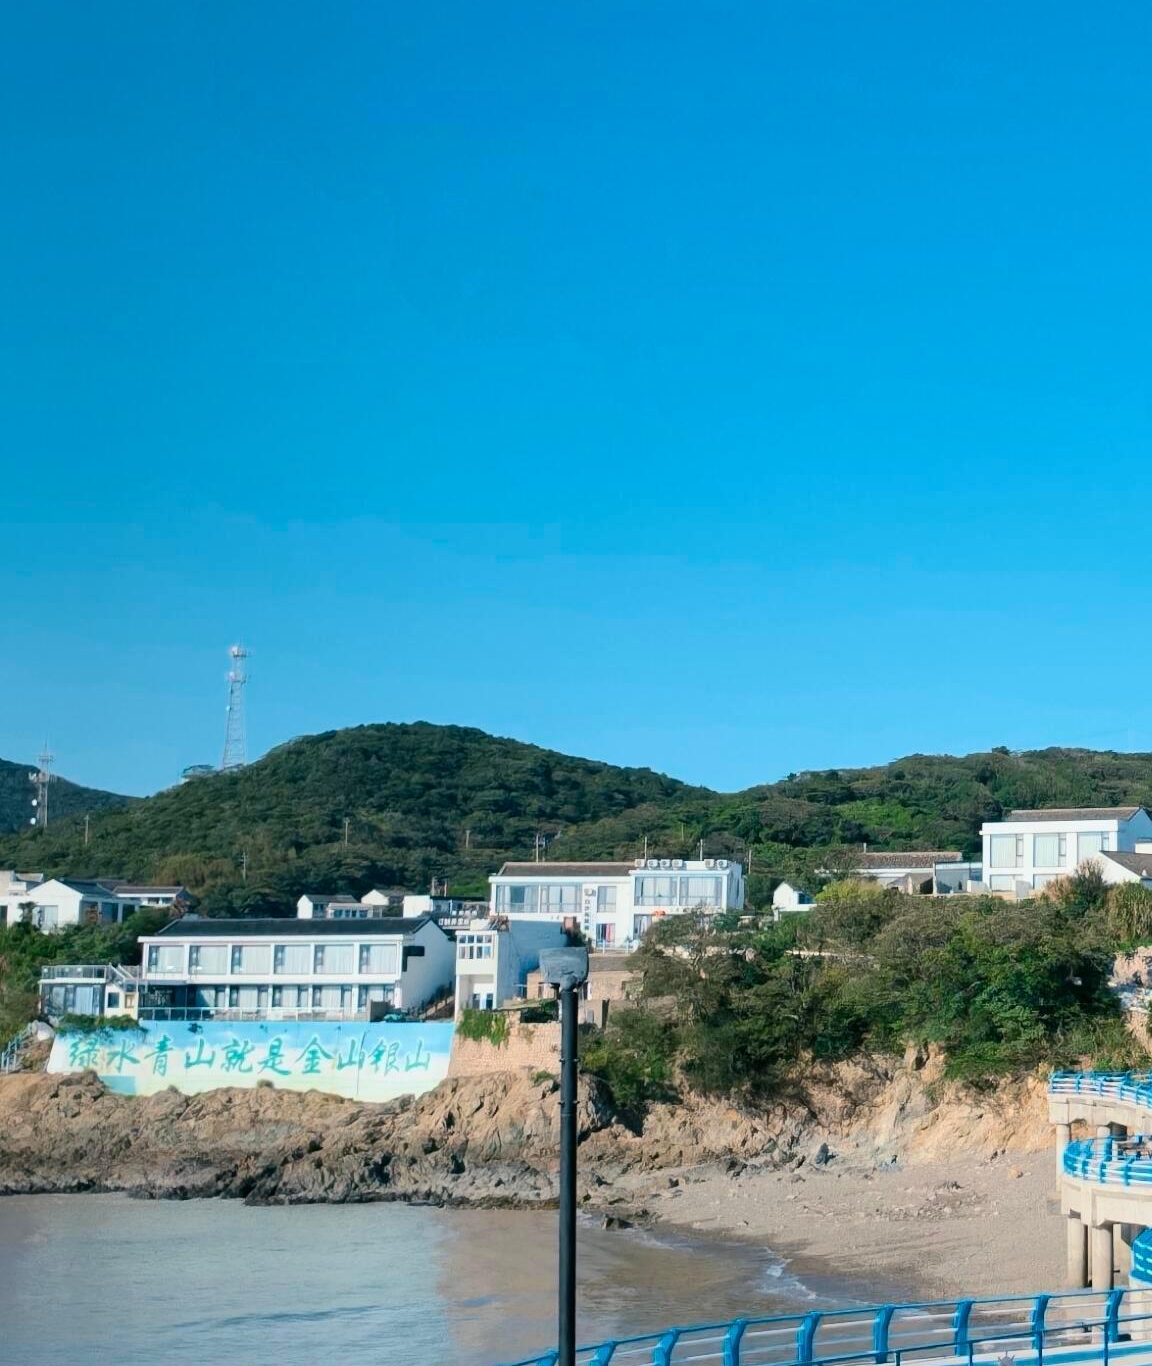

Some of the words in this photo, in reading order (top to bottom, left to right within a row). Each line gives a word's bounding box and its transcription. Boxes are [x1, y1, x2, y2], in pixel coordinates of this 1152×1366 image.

[68, 1034, 431, 1077] 绿水青山就是金山银山
